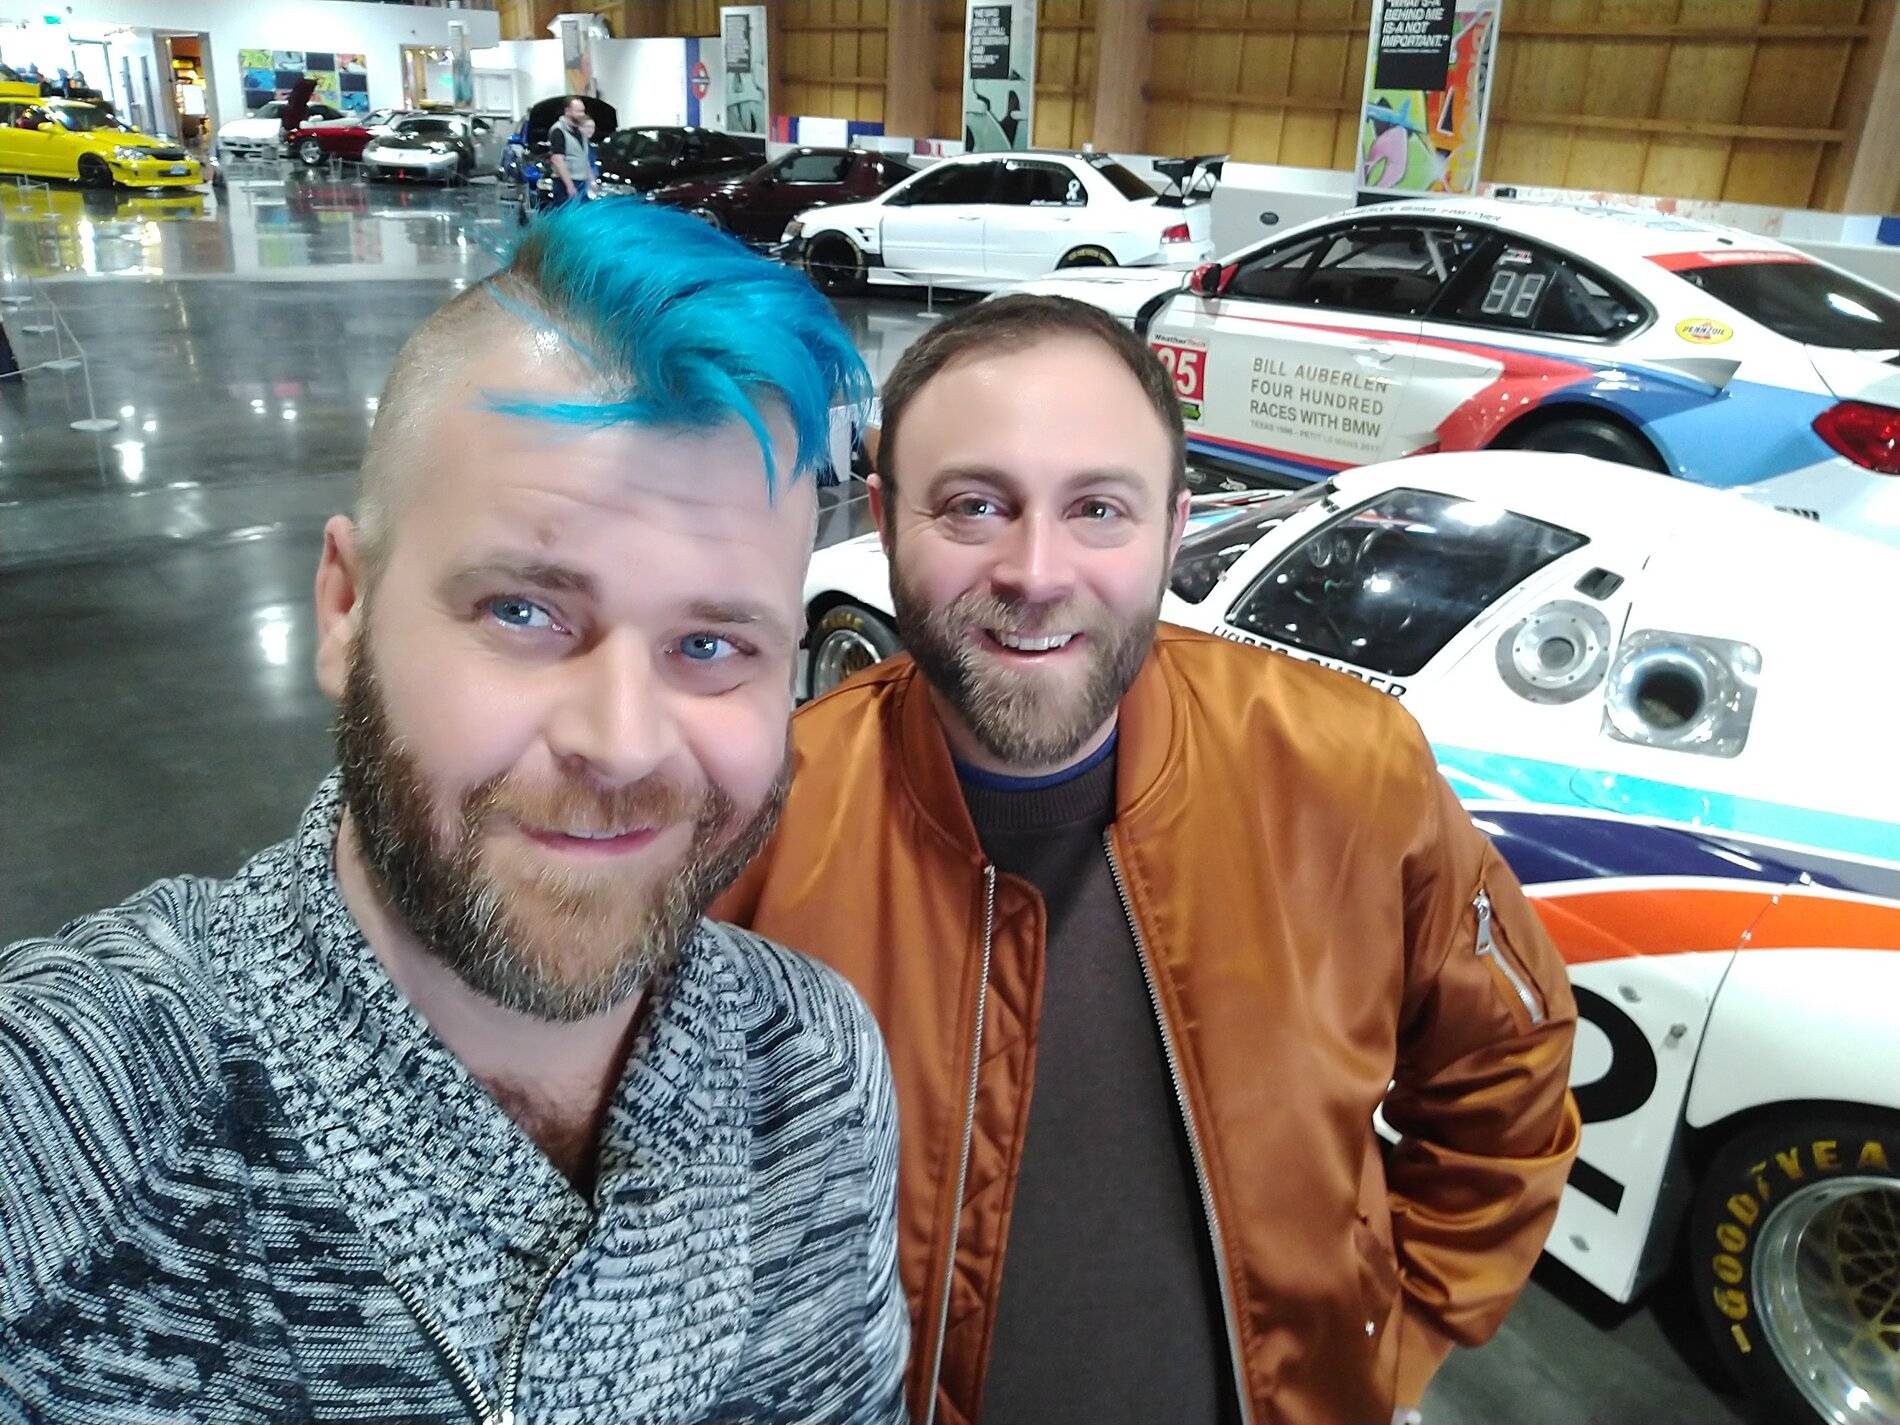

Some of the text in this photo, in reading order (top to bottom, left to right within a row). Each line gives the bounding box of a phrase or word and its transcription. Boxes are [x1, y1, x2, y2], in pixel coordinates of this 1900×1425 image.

[1384, 8, 1445, 21] BEHIND ME
[1405, 21, 1431, 34] NOT
[1682, 325, 1727, 336] PENNZOIL
[1253, 357, 1388, 394] BILL AUBERLEN
[1250, 379, 1384, 416] FOUR HUNDRED
[1249, 399, 1381, 438] RACES WITH BMW
